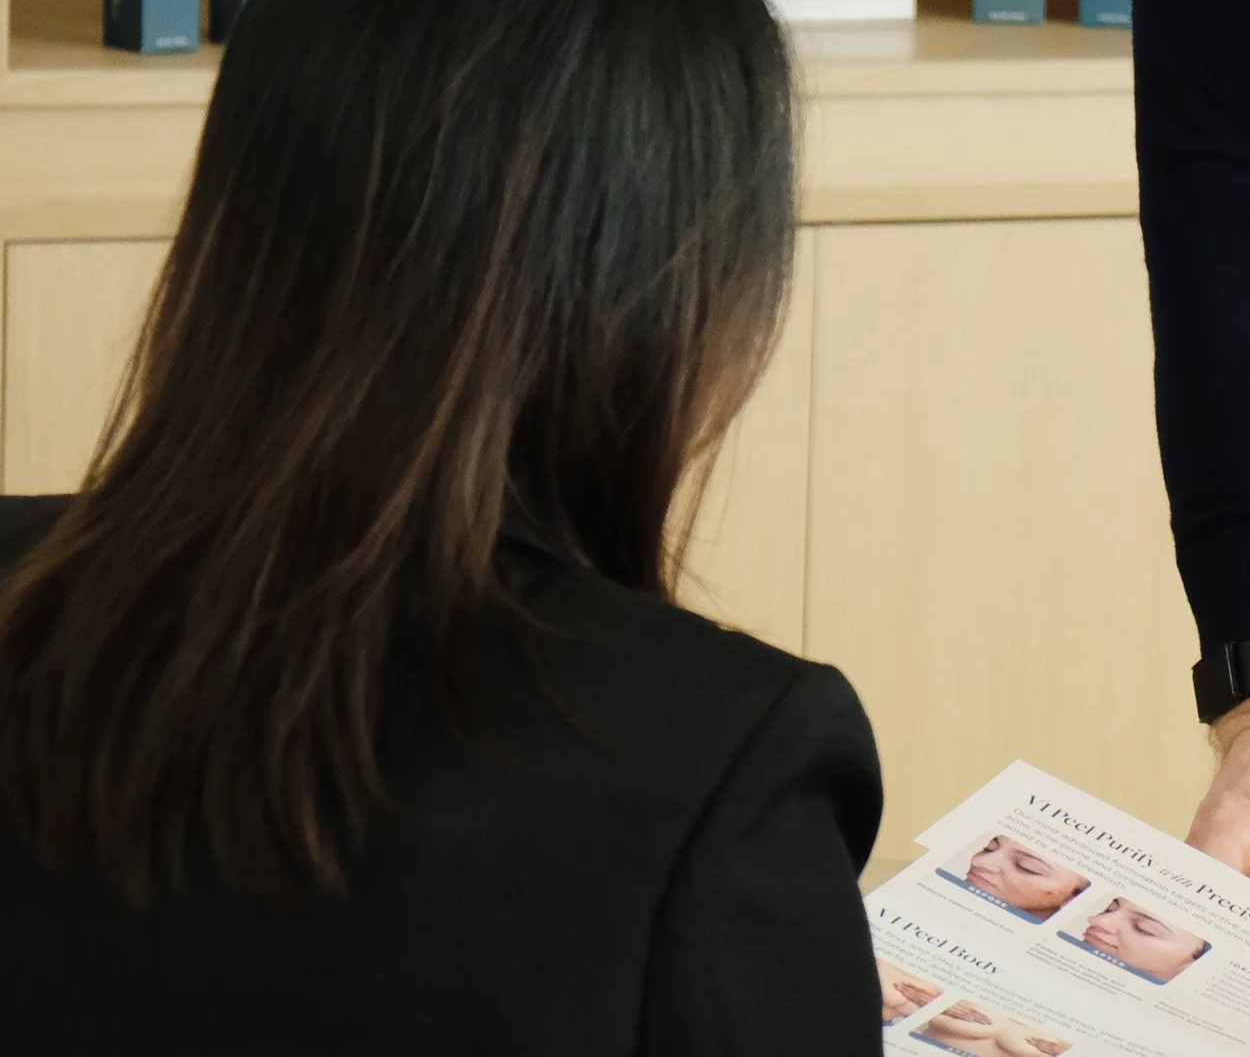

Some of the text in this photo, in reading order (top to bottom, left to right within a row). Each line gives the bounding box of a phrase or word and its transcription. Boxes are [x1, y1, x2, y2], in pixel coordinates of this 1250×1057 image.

[1028, 795, 1050, 812] VI
[1052, 808, 1095, 835] Peel
[1096, 831, 1159, 868] Purify
[1159, 867, 1193, 888] with
[967, 885, 1008, 909] BEFORE
[879, 908, 1004, 975] VI Peel Body
